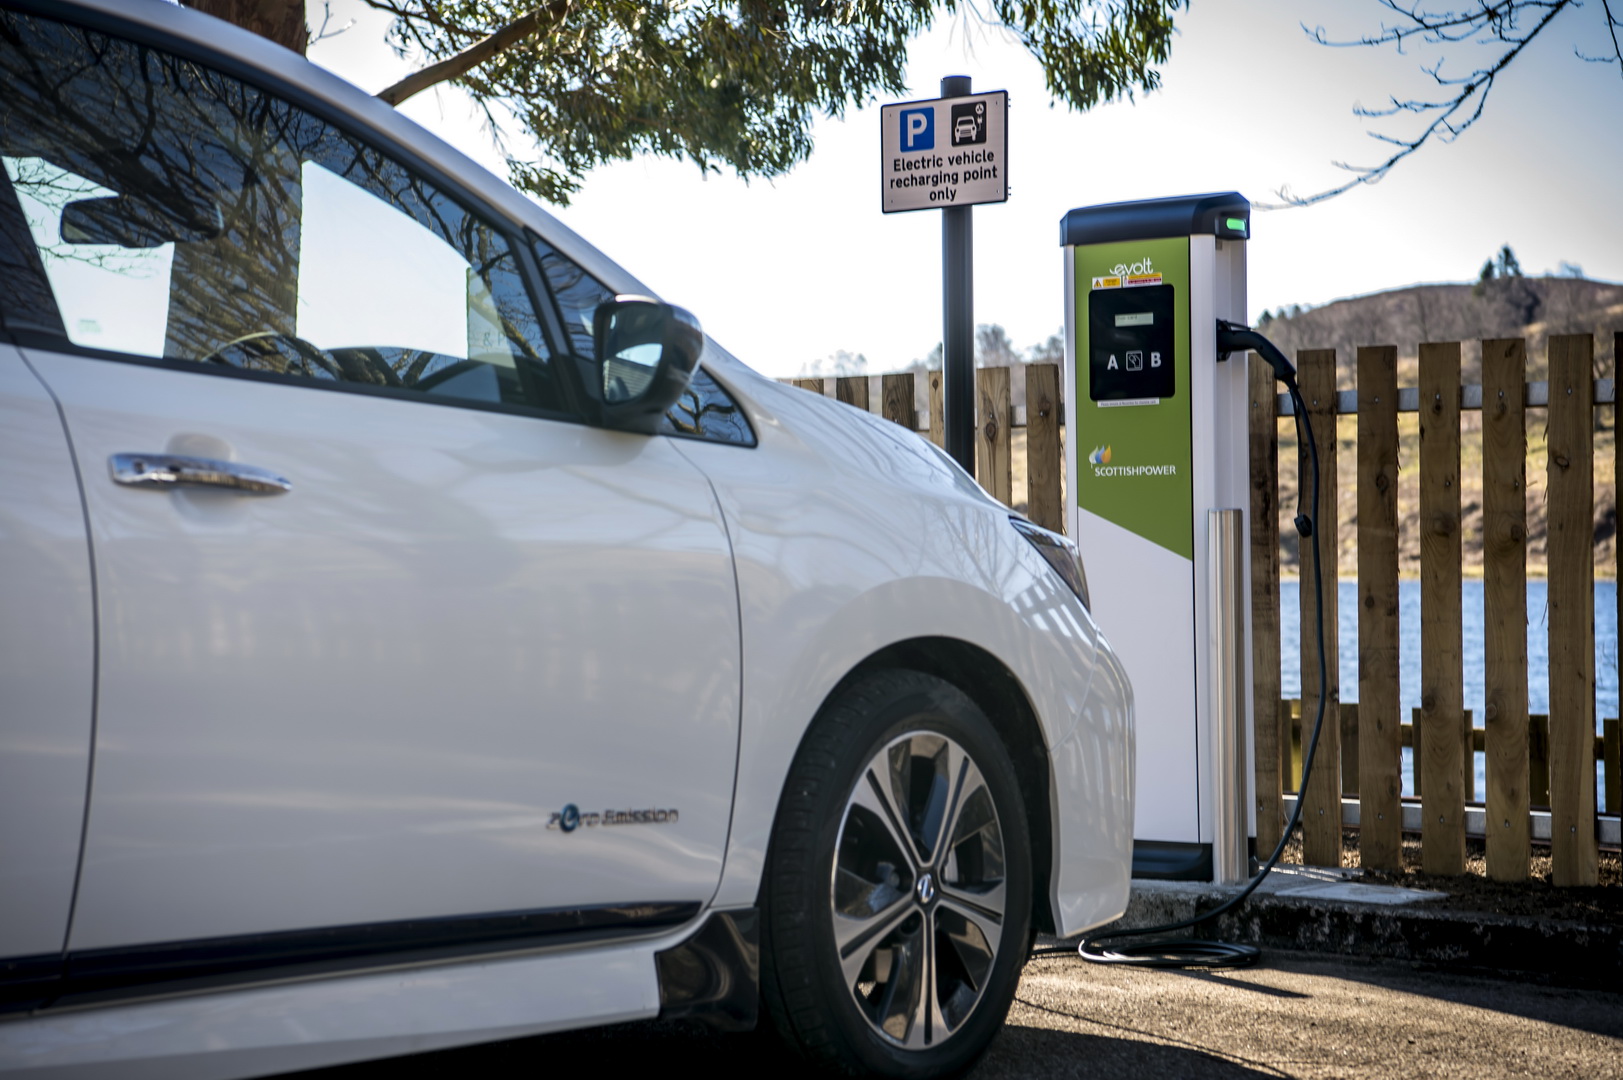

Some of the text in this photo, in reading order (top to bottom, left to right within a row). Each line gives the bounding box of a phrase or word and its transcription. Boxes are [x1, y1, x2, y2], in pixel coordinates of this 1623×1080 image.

[907, 112, 928, 147] P
[893, 148, 994, 172] Electric vehicle
[890, 165, 998, 189] recharging point
[929, 186, 957, 202] only
[1109, 256, 1154, 277] evolt
[1107, 351, 1162, 370] A B
[1094, 464, 1177, 477] SCOTTISHPOWER
[601, 806, 679, 826] Emission
